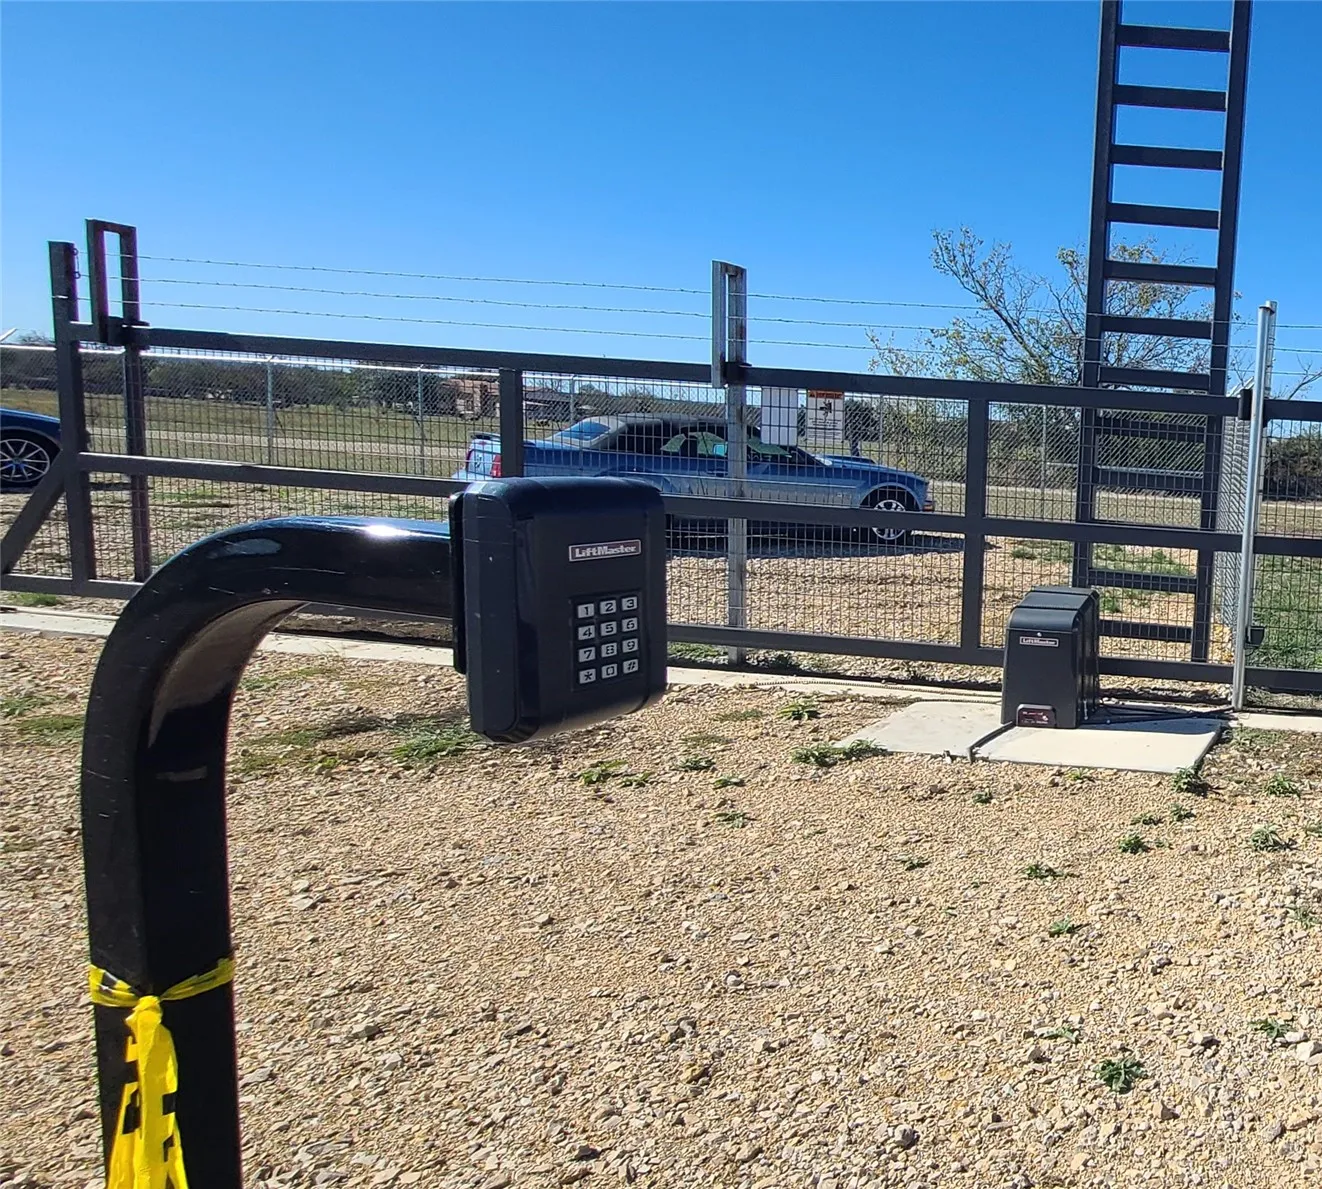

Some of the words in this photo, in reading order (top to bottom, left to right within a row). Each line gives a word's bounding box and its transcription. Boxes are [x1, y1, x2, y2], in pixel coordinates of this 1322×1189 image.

[575, 545, 637, 558] LiftMaster
[605, 602, 614, 612] 2
[626, 599, 635, 608] 3
[583, 628, 592, 637] 4
[605, 624, 614, 633] 5
[627, 620, 635, 629] 6
[584, 650, 592, 659] 7
[606, 645, 614, 654] 8
[627, 641, 635, 650] 9
[606, 667, 615, 676] 0
